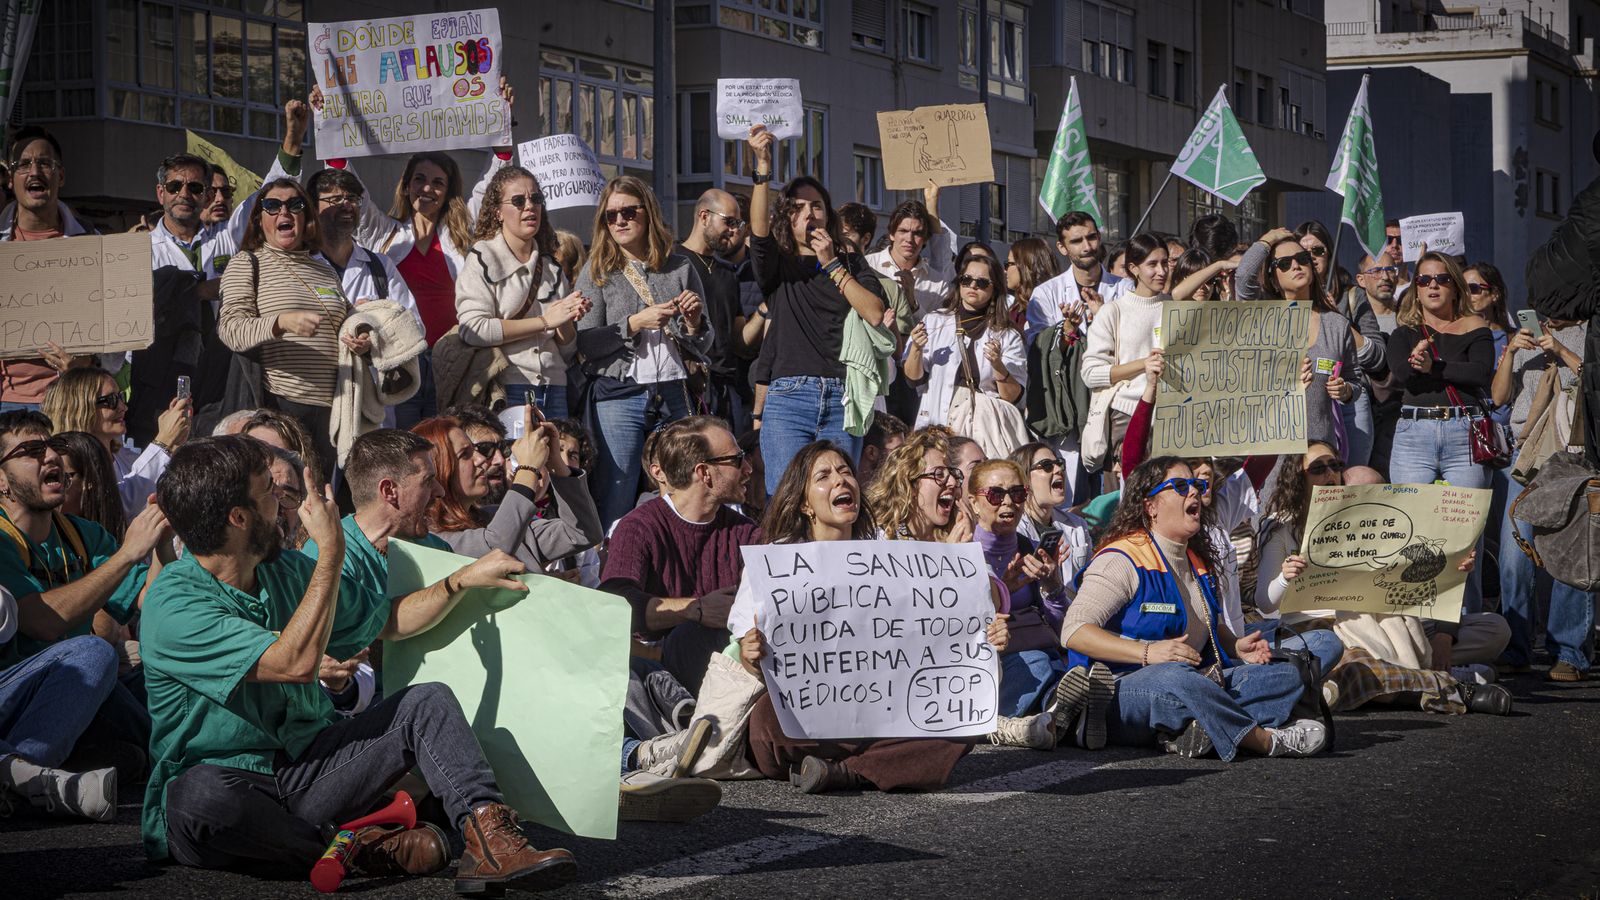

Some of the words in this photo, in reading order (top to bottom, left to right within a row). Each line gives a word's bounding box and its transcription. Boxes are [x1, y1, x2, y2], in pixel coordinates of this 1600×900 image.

[431, 12, 482, 39] ESTÁN
[324, 54, 357, 88] LOS
[379, 37, 492, 84] APLAUSOS
[322, 89, 387, 119] AHORA
[402, 84, 432, 109] QUE
[452, 76, 485, 98] OS
[522, 144, 530, 157] A
[531, 141, 541, 154] MI
[543, 135, 567, 151] PADRE
[524, 159, 536, 170] SIN
[539, 152, 562, 167] HABER
[88, 285, 138, 302] CON
[1169, 307, 1202, 346] MI
[1210, 301, 1310, 349] VOCACIÓN
[1161, 352, 1196, 394] NO
[1199, 349, 1299, 393] JUSTIFICA
[1156, 396, 1192, 449] TÚ
[1192, 391, 1305, 448] EXPLOTACIÓN
[1324, 521, 1350, 532] CREO
[1359, 519, 1377, 528] QUE
[1383, 518, 1395, 527] DE
[1346, 533, 1356, 541] YA
[764, 552, 814, 578] LA
[846, 552, 977, 579] SANIDAD
[1329, 551, 1343, 559] SER
[771, 582, 892, 616] PÚBLICA
[912, 586, 958, 609] NO
[772, 620, 855, 647] CUIDA
[874, 617, 904, 639] DE
[920, 645, 936, 666] A
[949, 642, 993, 664] SUS
[778, 679, 892, 711] MÉDICOS!
[915, 673, 982, 698] STOP
[924, 698, 989, 724] 24hr
